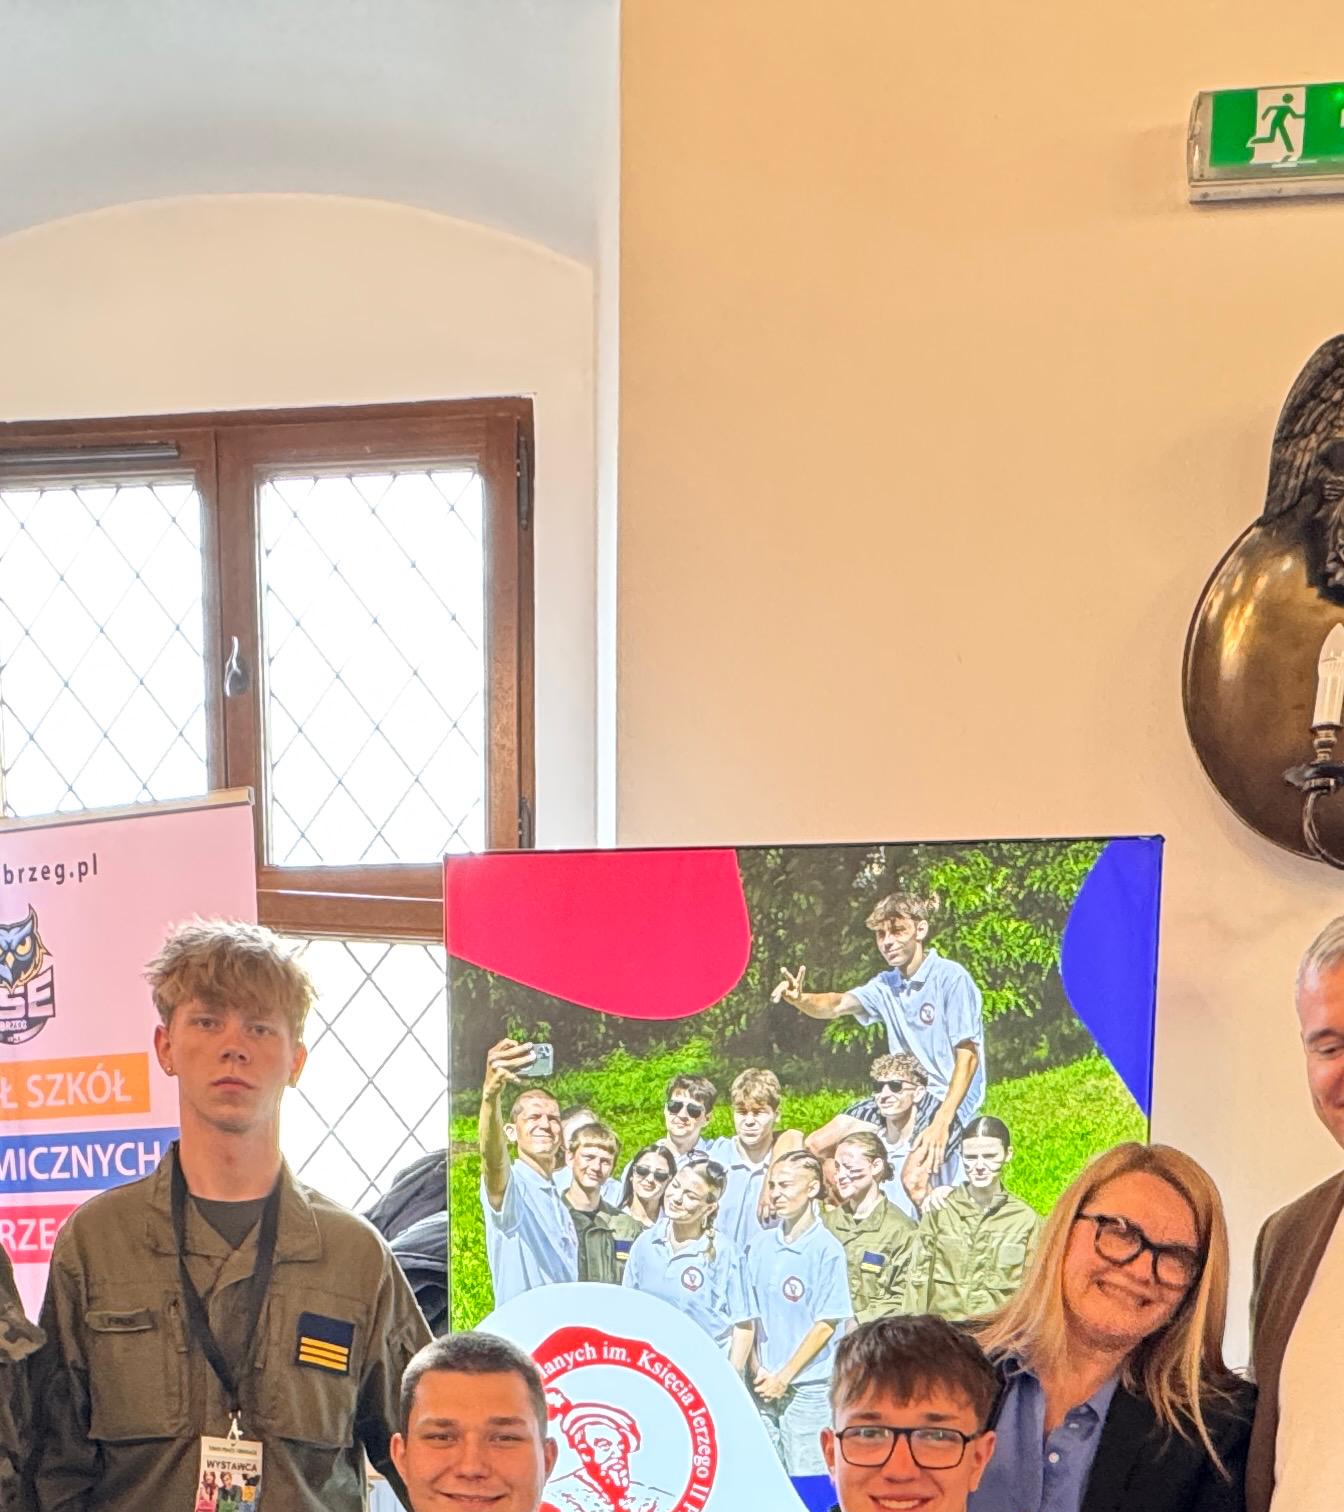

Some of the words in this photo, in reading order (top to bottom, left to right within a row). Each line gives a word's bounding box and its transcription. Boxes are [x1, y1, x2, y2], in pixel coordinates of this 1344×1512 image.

[27, 1062, 132, 1108] SZKÓŁ
[603, 1341, 631, 1363] im.
[637, 1350, 694, 1406] Księcia
[689, 1408, 712, 1477] Jerzego
[206, 1459, 258, 1473] WYSTAWCA
